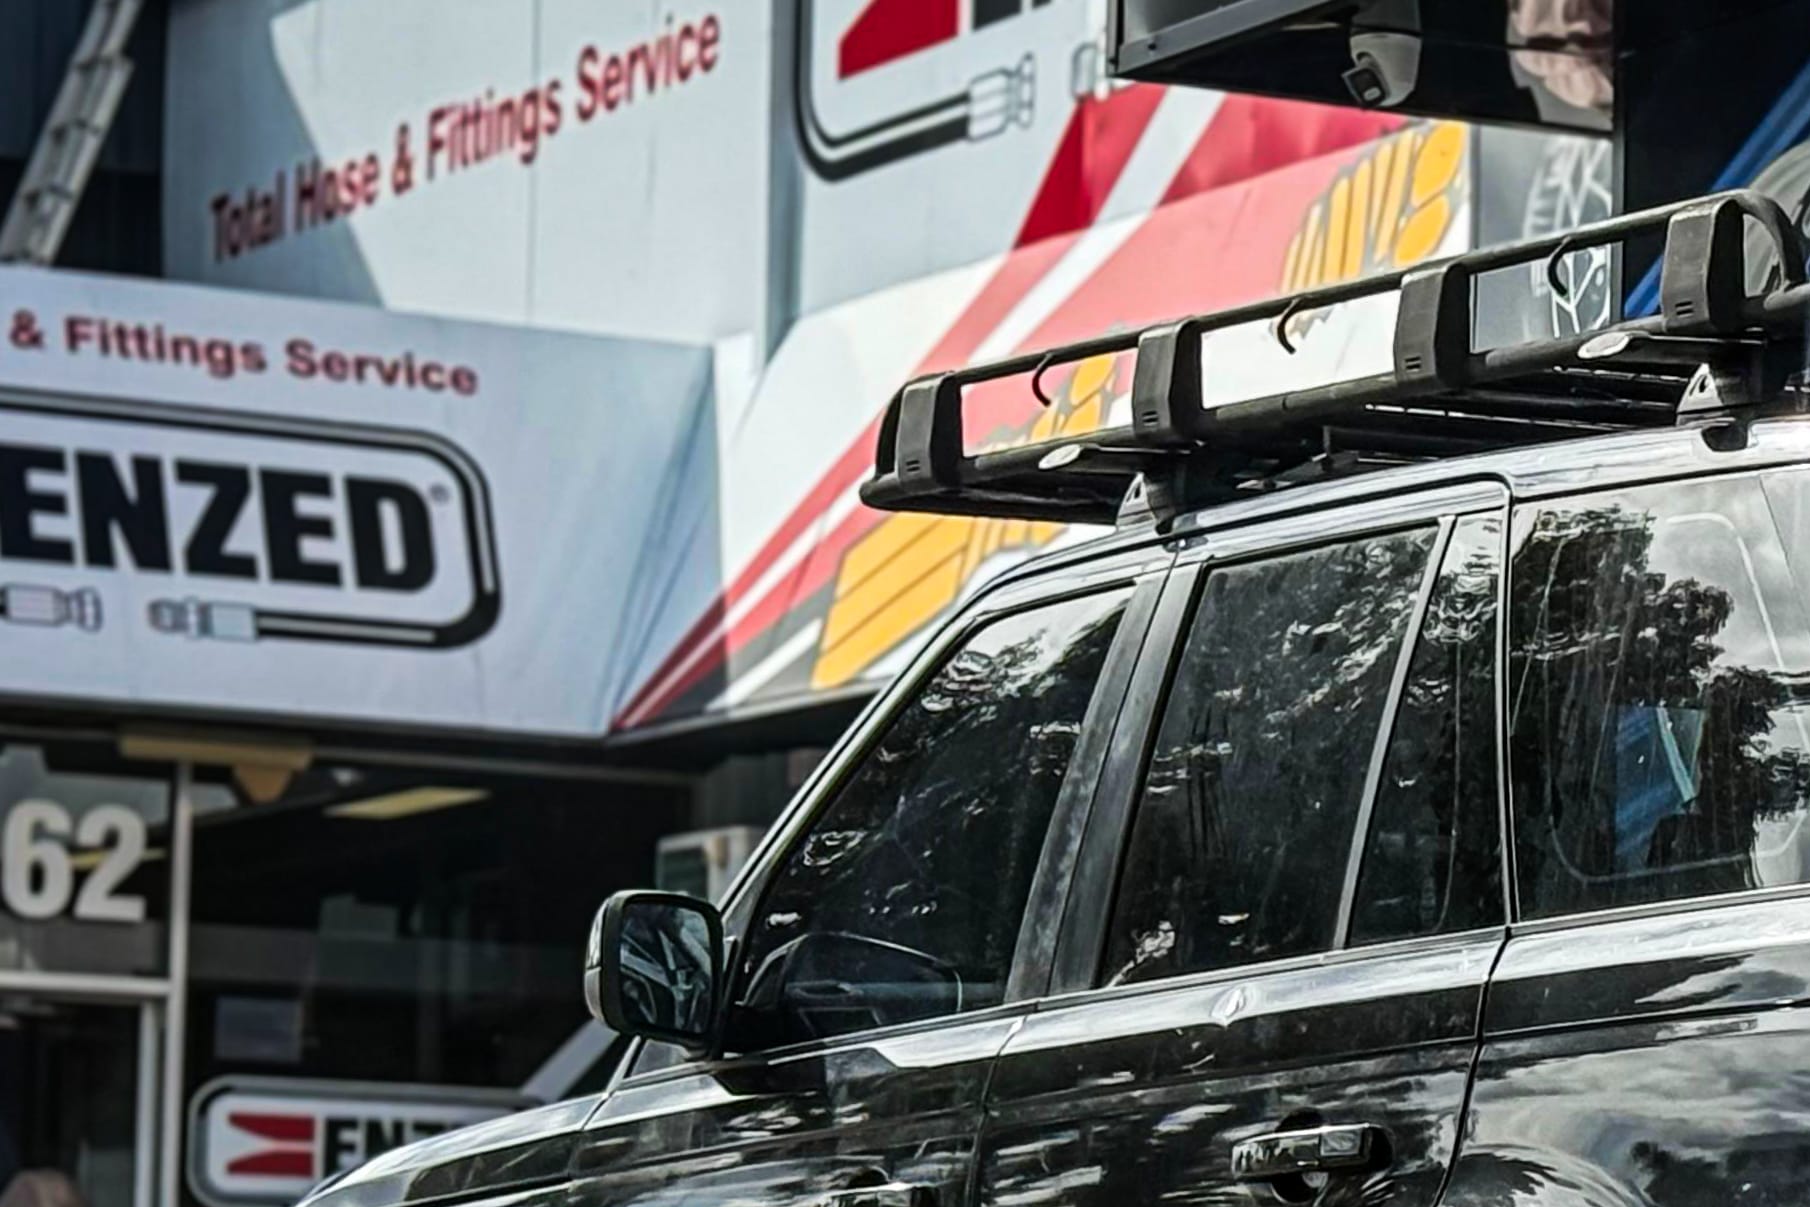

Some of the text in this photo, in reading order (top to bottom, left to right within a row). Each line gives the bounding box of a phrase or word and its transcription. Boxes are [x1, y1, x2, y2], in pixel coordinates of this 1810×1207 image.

[209, 13, 720, 263] Total Hose & Fittings Service
[9, 309, 479, 396] & Fittings Service
[3, 799, 148, 922] 62
